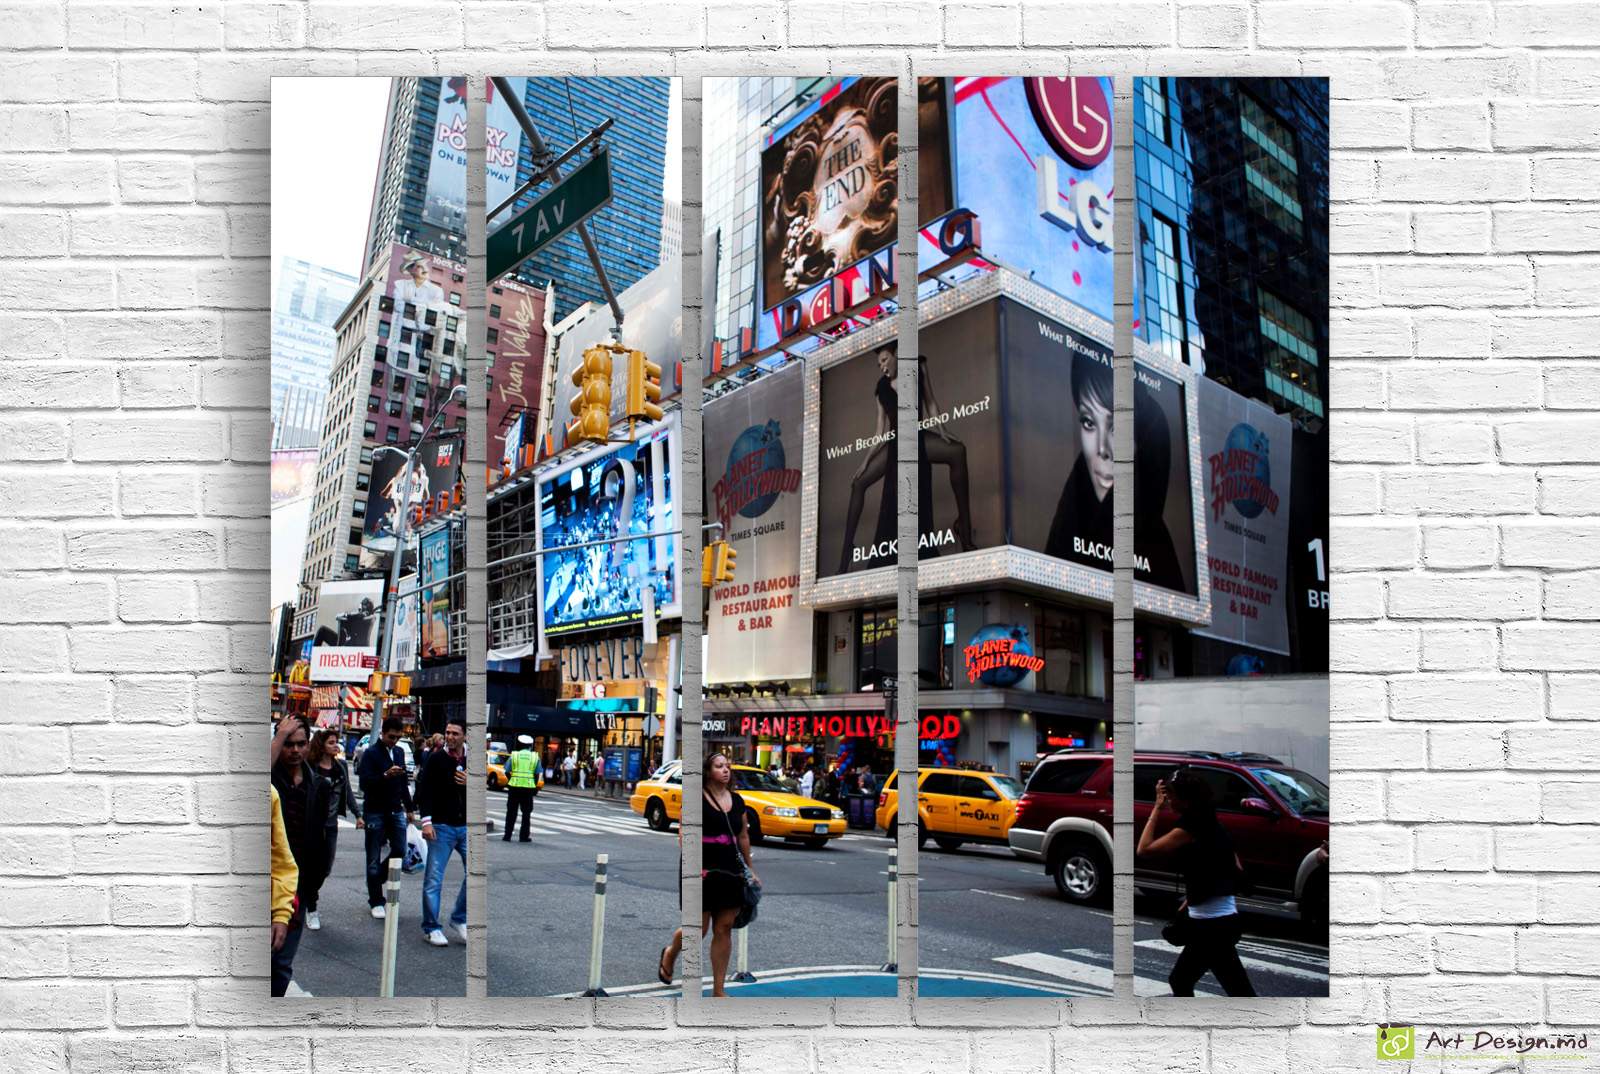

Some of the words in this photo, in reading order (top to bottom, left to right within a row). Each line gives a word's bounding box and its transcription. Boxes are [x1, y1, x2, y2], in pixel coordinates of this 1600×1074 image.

[438, 149, 454, 161] ON
[823, 138, 864, 179] THE
[823, 166, 866, 215] END
[1036, 155, 1114, 254] LG
[511, 222, 525, 254] 7
[534, 198, 566, 242] AV
[1101, 352, 1109, 366] A
[499, 361, 529, 407] Juan
[917, 411, 950, 432] EGEND
[711, 447, 768, 519] PLANET
[1208, 447, 1264, 495] PLANET
[717, 467, 803, 536] HOLLYWOOD
[1210, 474, 1280, 523] HOLLYWOOD
[730, 528, 752, 544] TIMES
[753, 520, 786, 537] SQUARE
[714, 583, 751, 601] WORLD
[1213, 576, 1273, 606] RESTAURANT
[1243, 566, 1279, 591] FAMOUS
[721, 594, 794, 617] RESTAURANT
[1229, 599, 1238, 615] &
[1240, 604, 1259, 620] BAR
[737, 618, 746, 632] &
[749, 615, 773, 631] BAR
[319, 651, 365, 668] maxell
[559, 635, 646, 682] FOREVER
[963, 639, 1018, 668] PLANET
[967, 652, 1045, 684] HOLLYWOOD
[740, 715, 808, 738] PLANET
